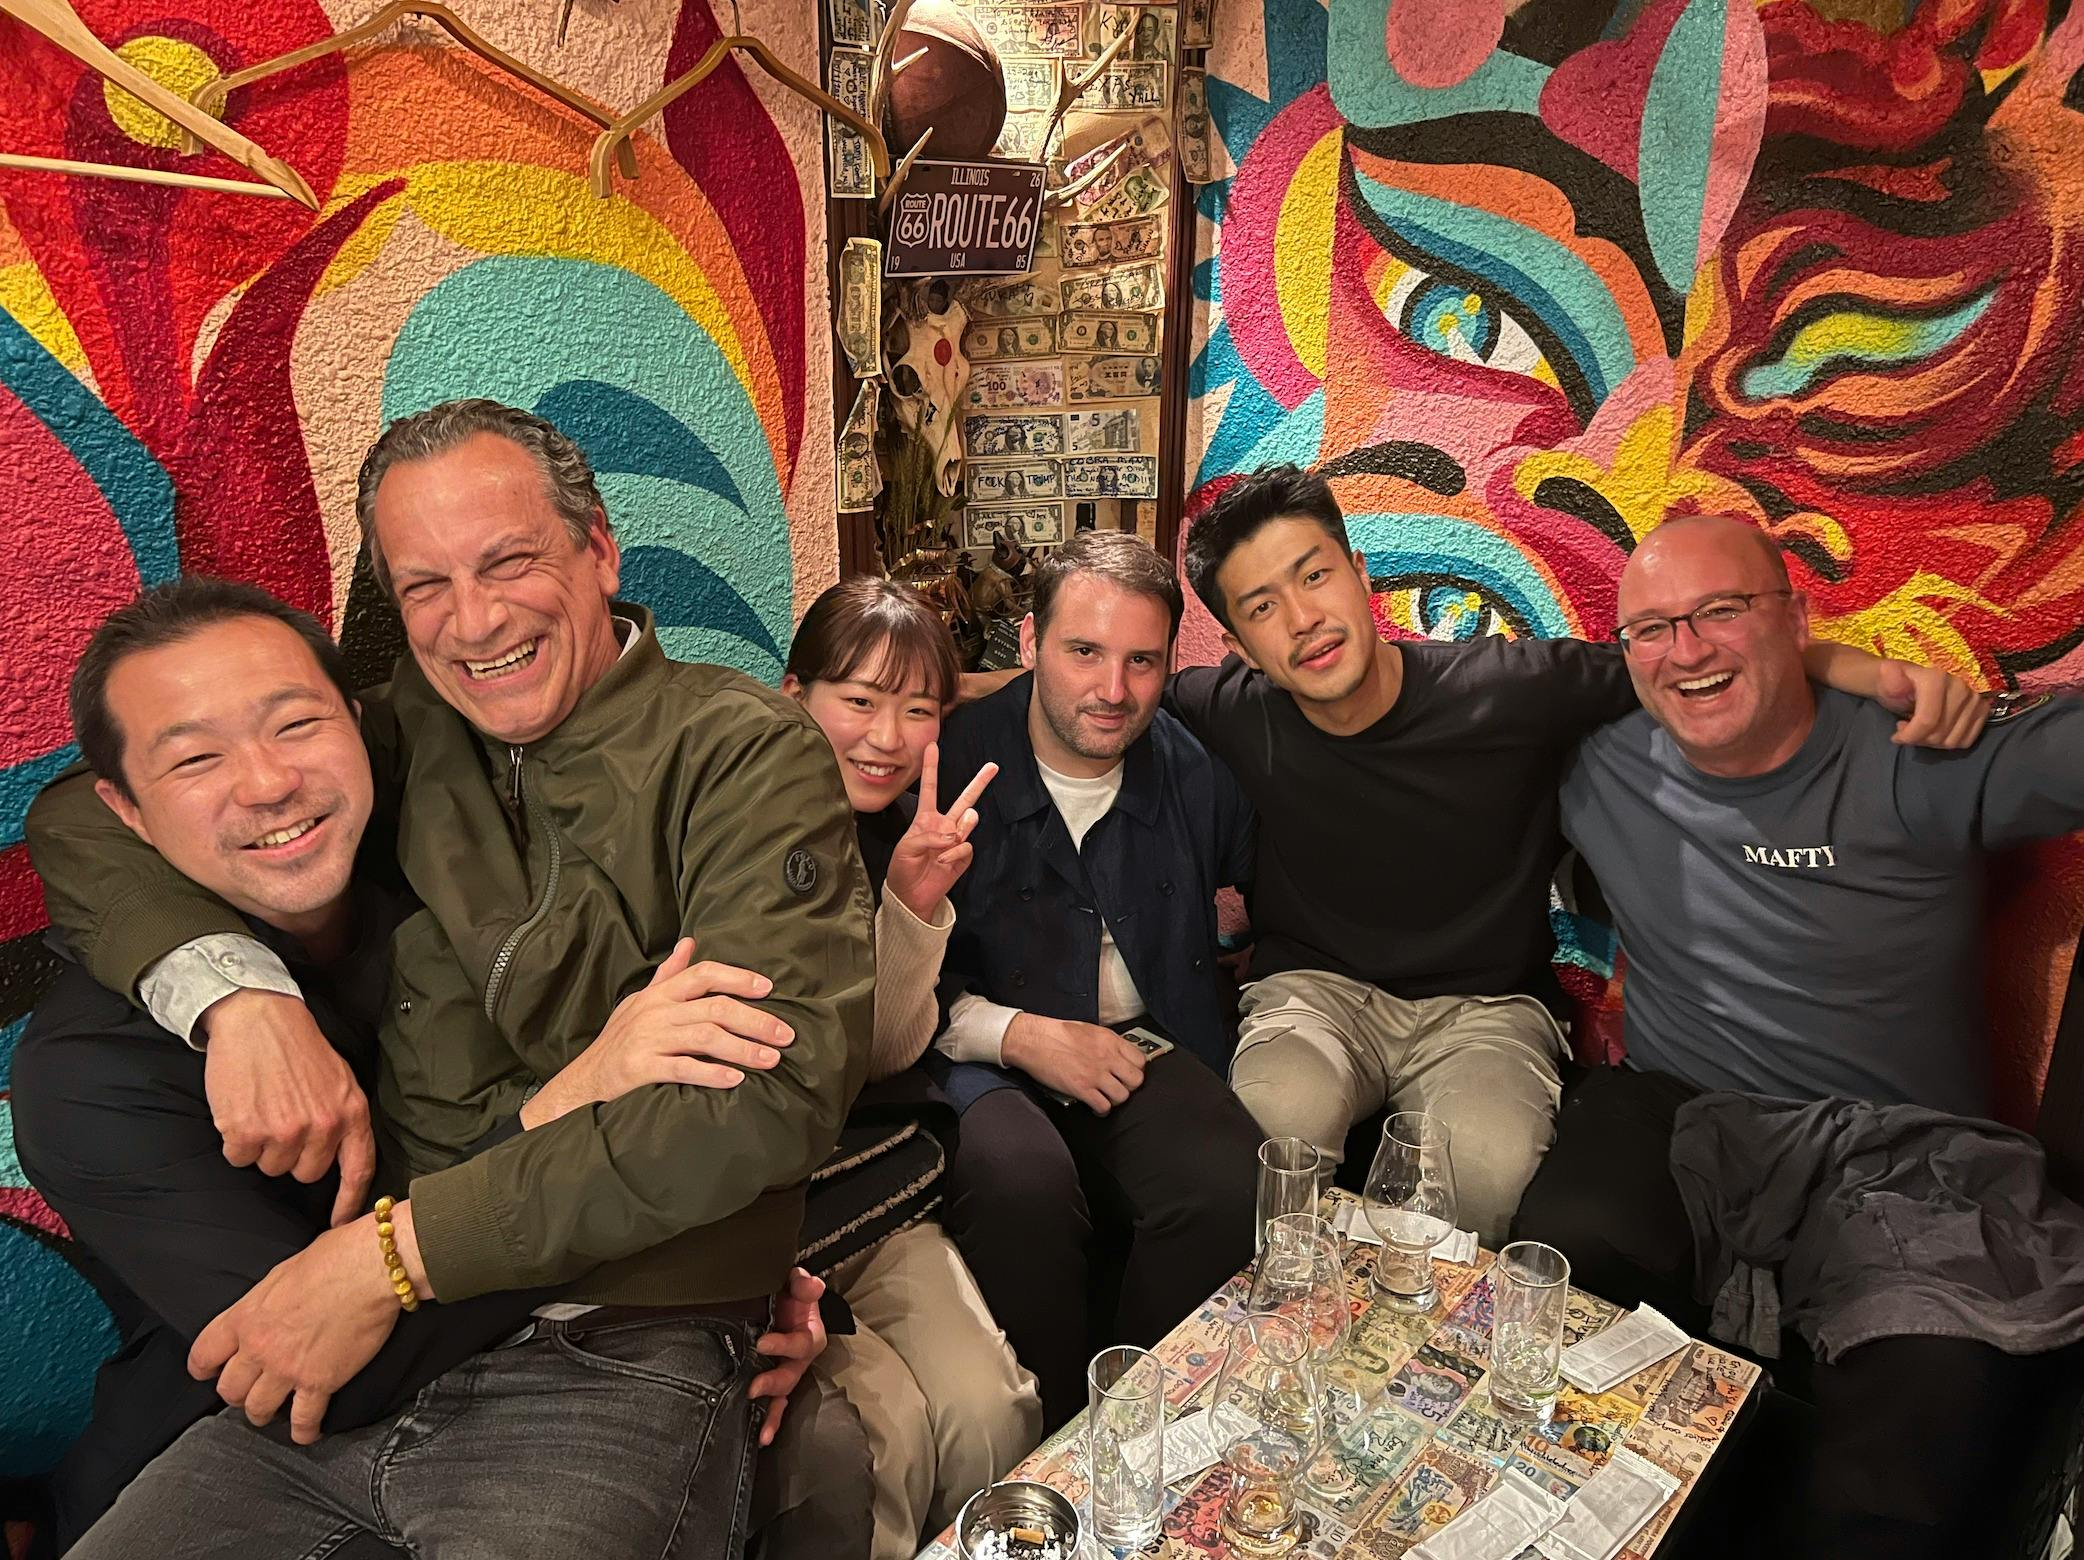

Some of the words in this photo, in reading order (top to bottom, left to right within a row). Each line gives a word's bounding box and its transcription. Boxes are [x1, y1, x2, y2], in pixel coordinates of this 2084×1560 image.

[951, 167, 990, 186] ILLINOIS
[1030, 173, 1041, 188] 26
[905, 199, 926, 209] ROUTE
[901, 213, 925, 239] 66
[890, 255, 900, 271] 19
[950, 252, 965, 268] USA
[1015, 254, 1027, 269] 85
[988, 381, 1006, 391] 100
[1091, 413, 1100, 427] 5
